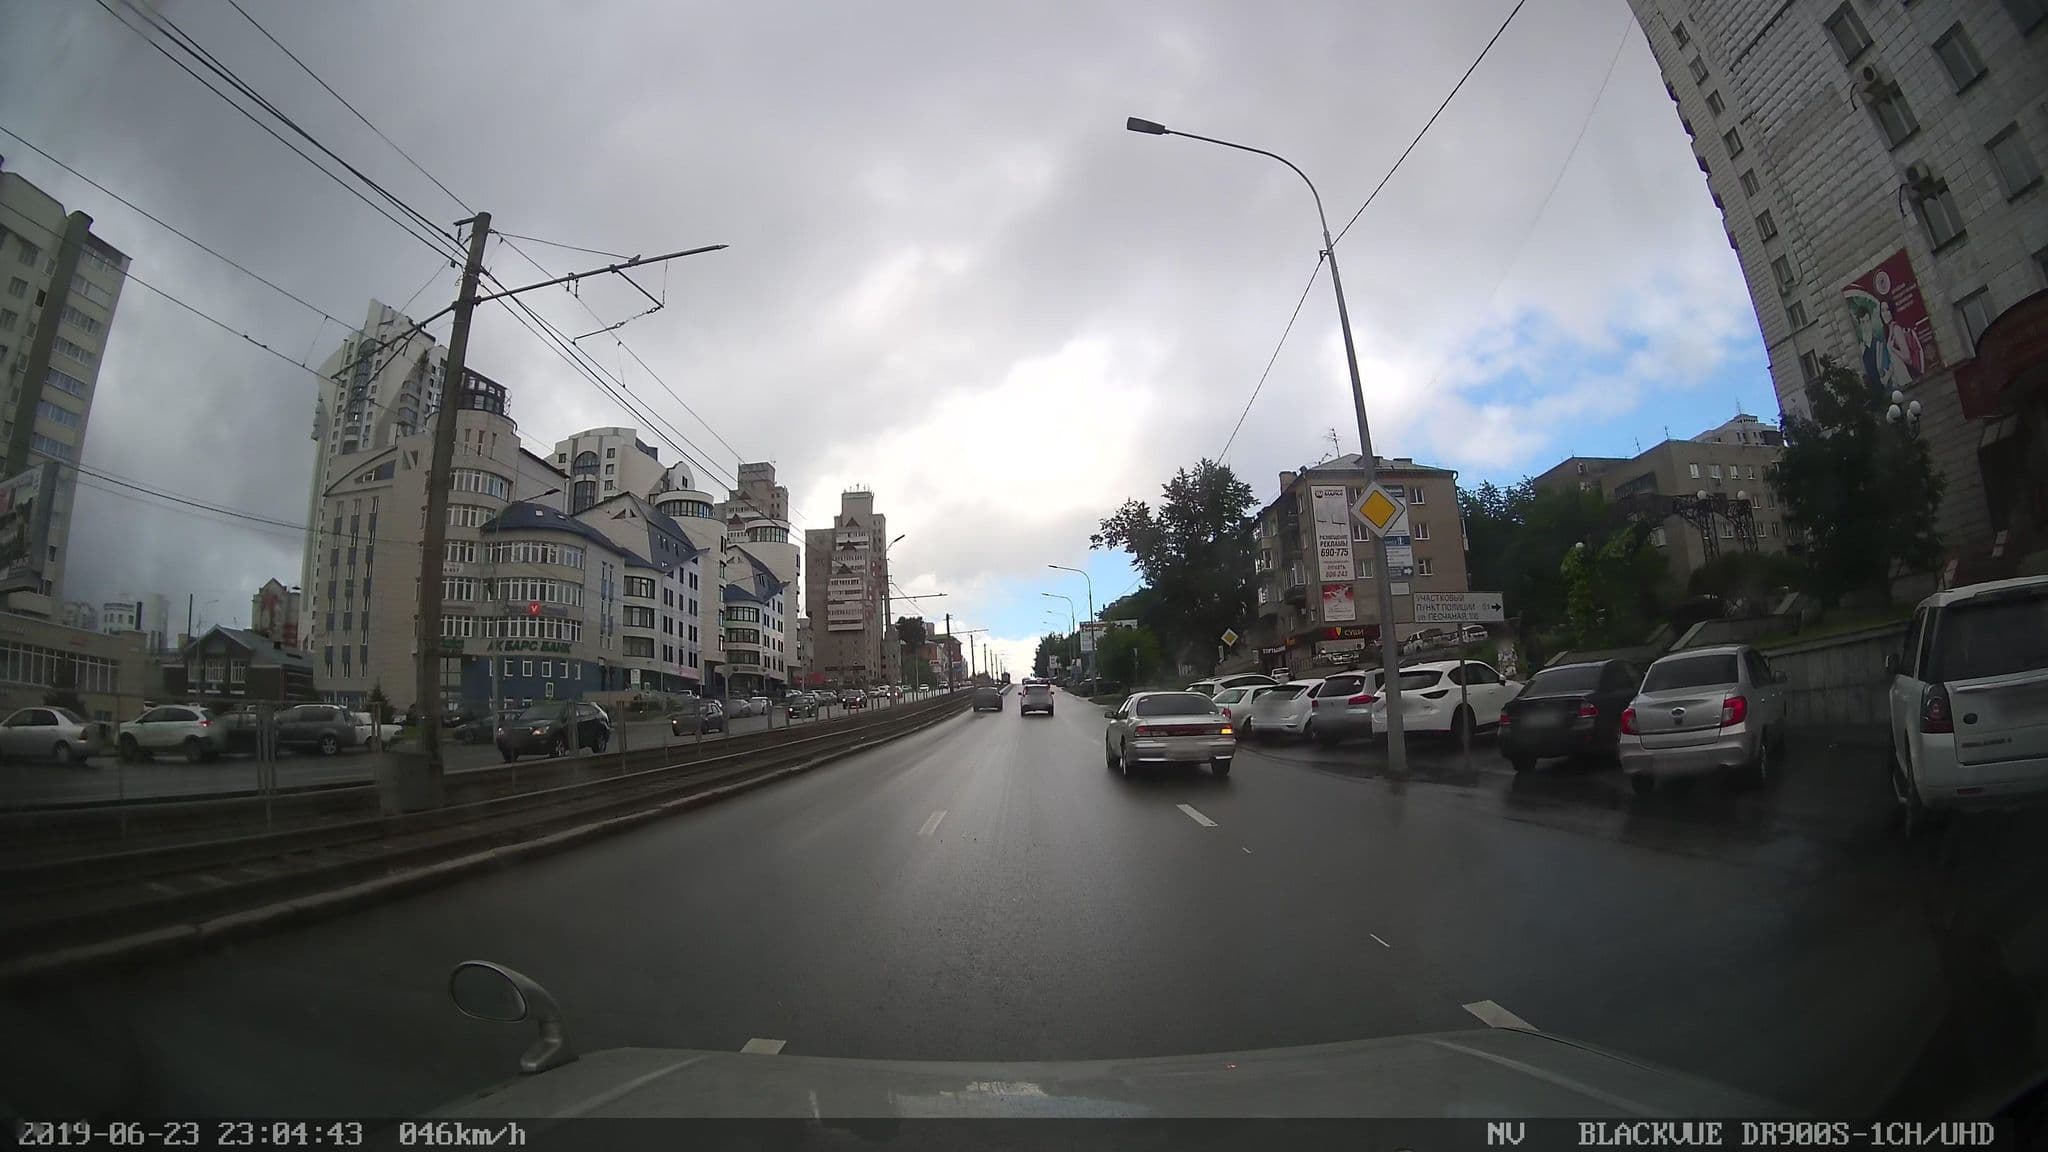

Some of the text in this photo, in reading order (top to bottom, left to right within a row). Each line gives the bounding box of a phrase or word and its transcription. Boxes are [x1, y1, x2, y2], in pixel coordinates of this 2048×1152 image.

[1320, 548, 1349, 557] 690-775
[1416, 594, 1465, 602] УЧАСТКОВЫЙ
[1416, 603, 1440, 611] ПУНКТ
[1441, 603, 1475, 612] ПОЛИЦИИ
[505, 640, 538, 652] БАРС
